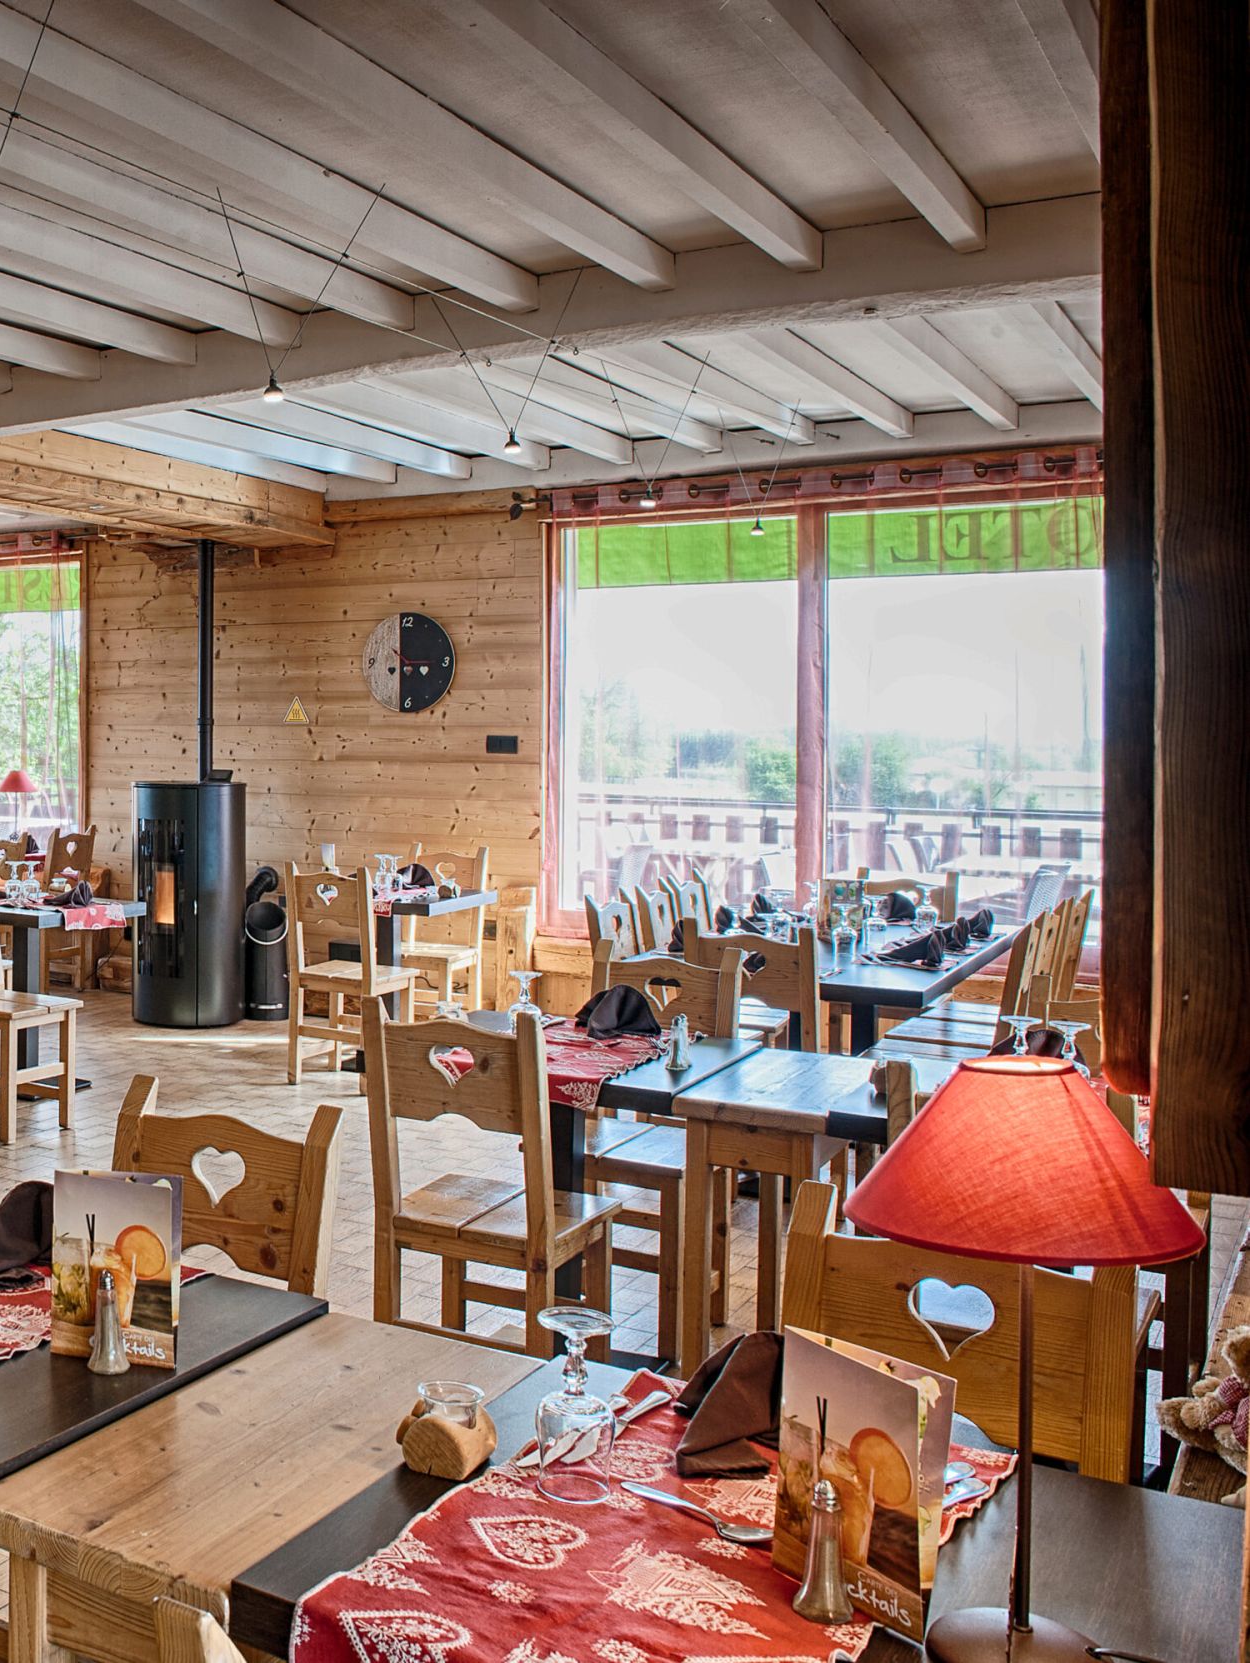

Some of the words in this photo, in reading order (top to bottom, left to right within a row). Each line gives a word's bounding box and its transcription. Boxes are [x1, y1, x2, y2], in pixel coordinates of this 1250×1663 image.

[402, 616, 413, 627] 12
[368, 657, 375, 669] 9
[441, 656, 450, 667] 3
[404, 697, 411, 708] 6
[846, 1580, 912, 1627] cktails
